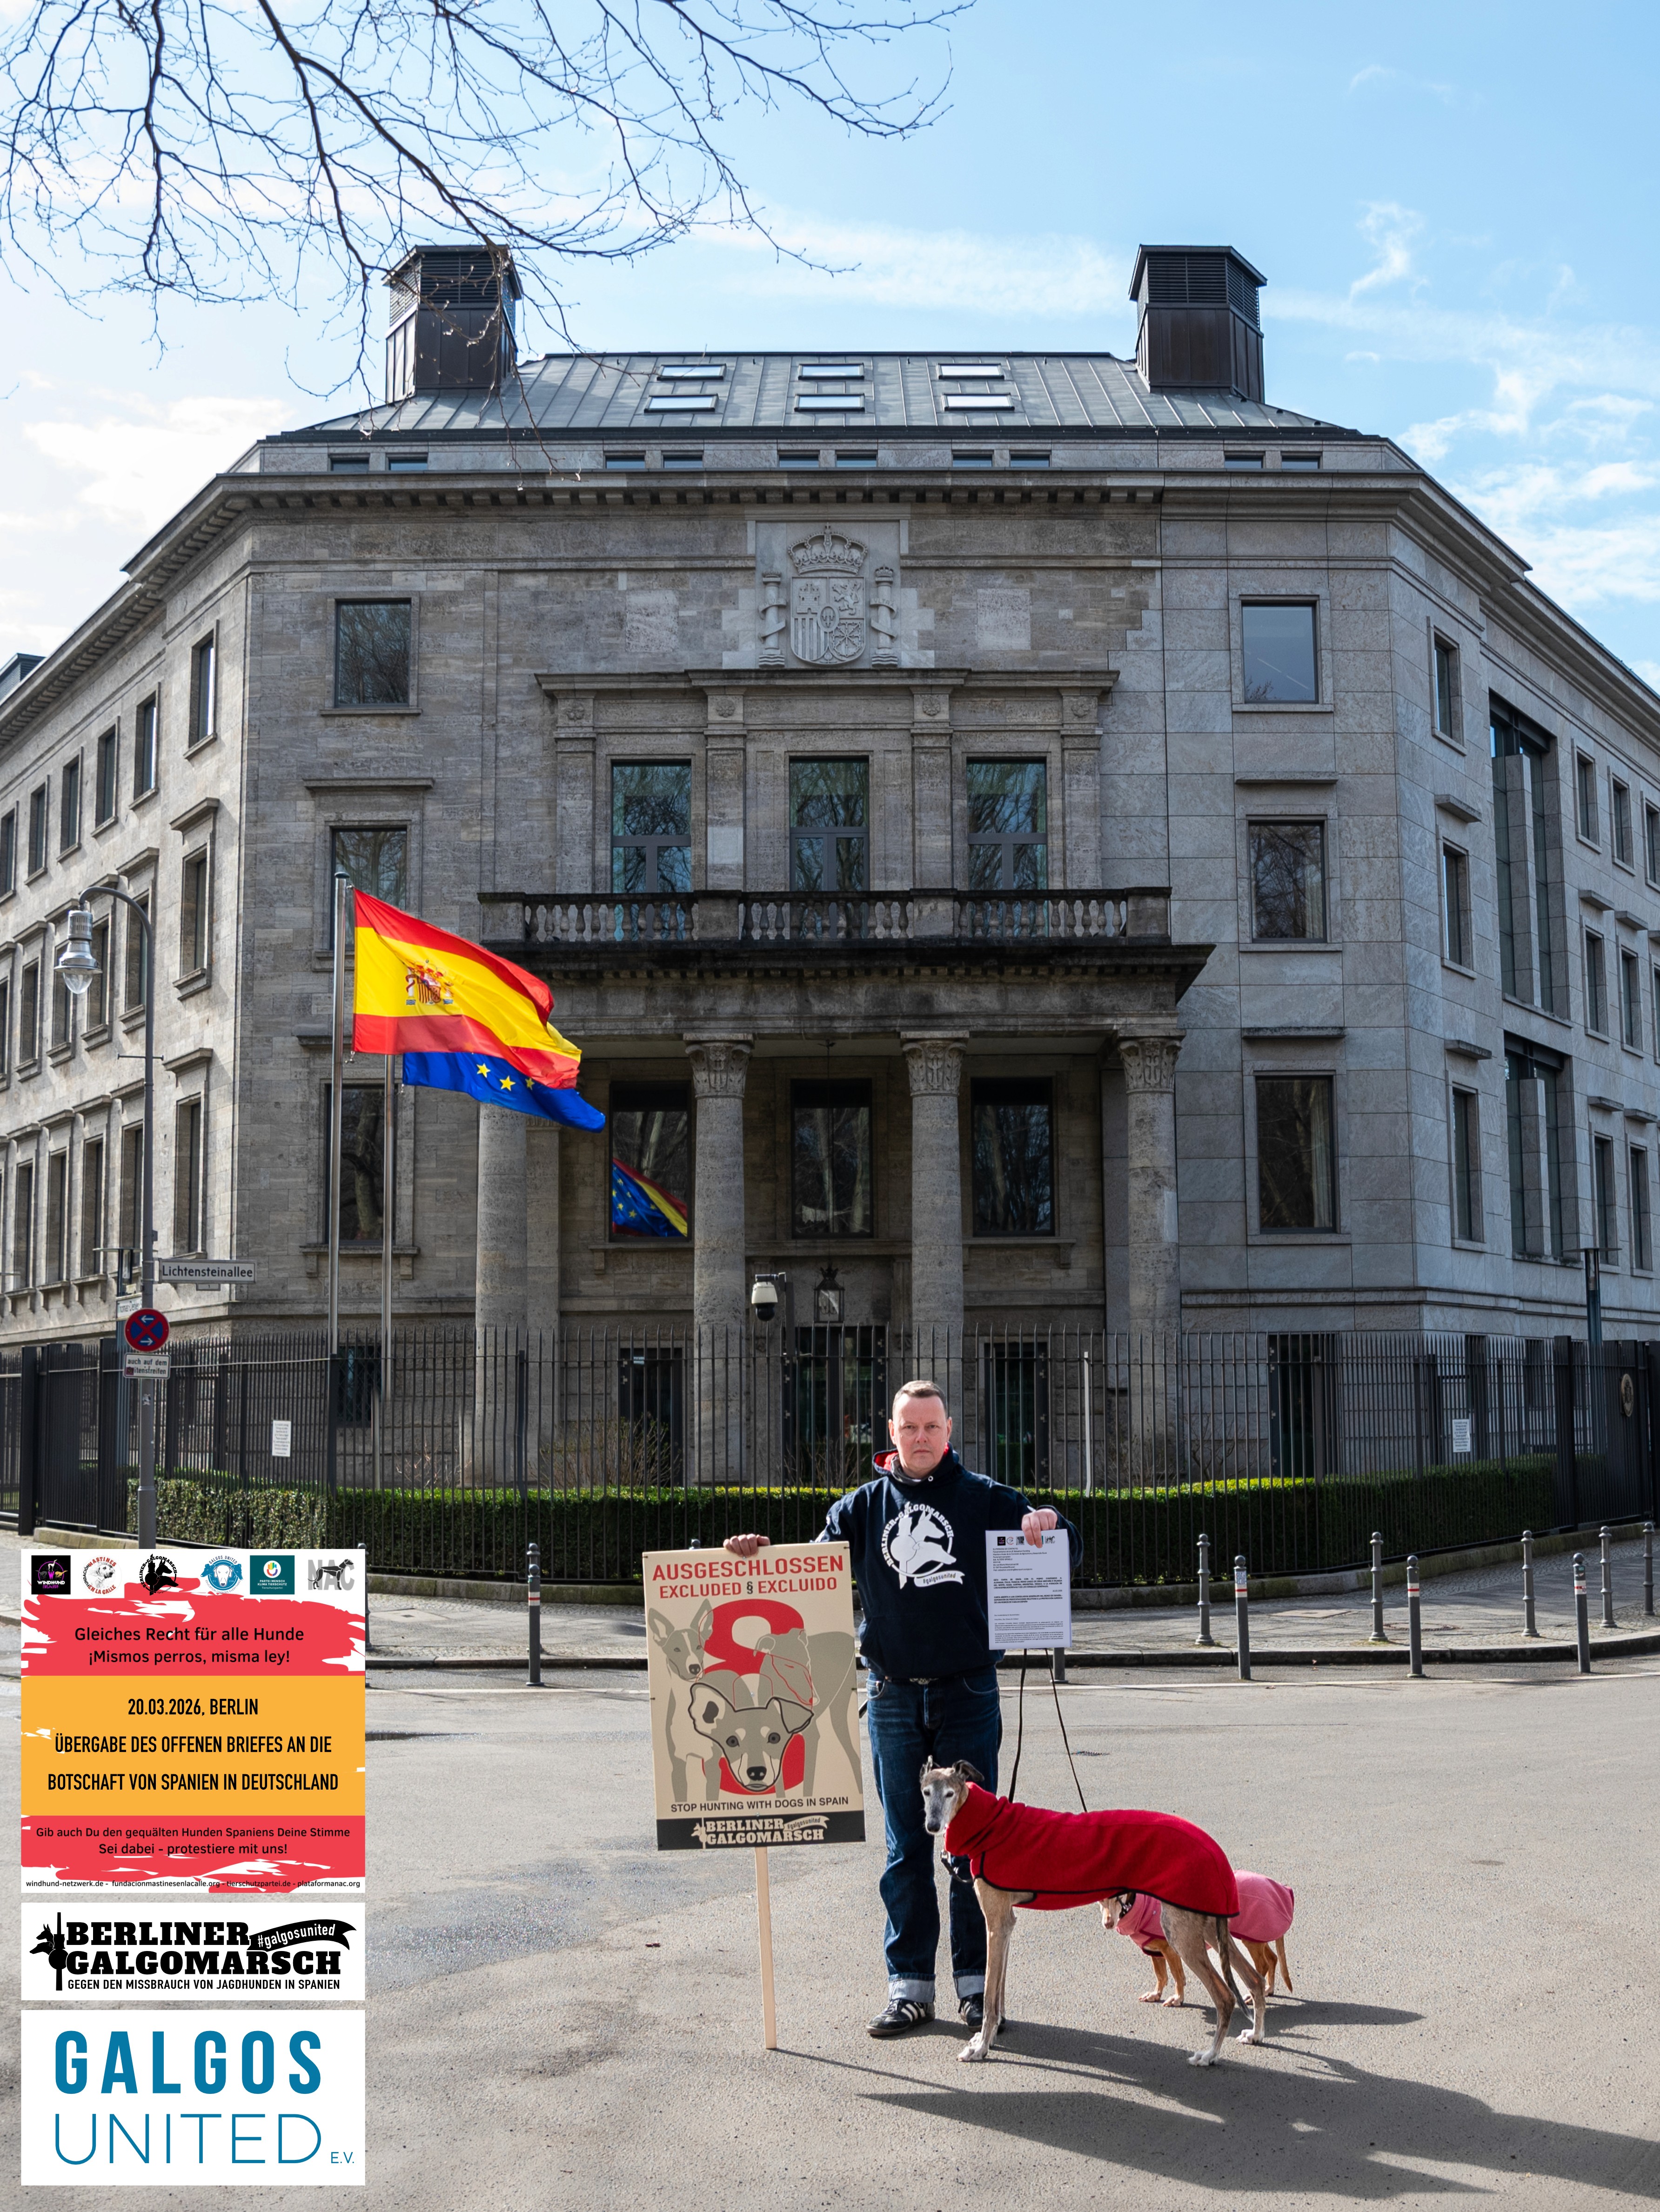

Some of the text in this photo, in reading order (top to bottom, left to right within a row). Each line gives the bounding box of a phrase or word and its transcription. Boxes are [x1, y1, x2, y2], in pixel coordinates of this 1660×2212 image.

[162, 1265, 253, 1277] Lichtensteinallee
[652, 1555, 843, 1581] AUSGESCHLOSSEN
[922, 1572, 957, 1585] #galgosunited
[659, 1582, 742, 1599] EXCLUDED
[758, 1577, 837, 1594] EXCLUIDO
[671, 1797, 849, 1812] STOP HUNTING WITH DOGS IN SPAIN
[705, 1818, 784, 1832] BERLINER
[706, 1829, 824, 1845] GALGOMARSCH
